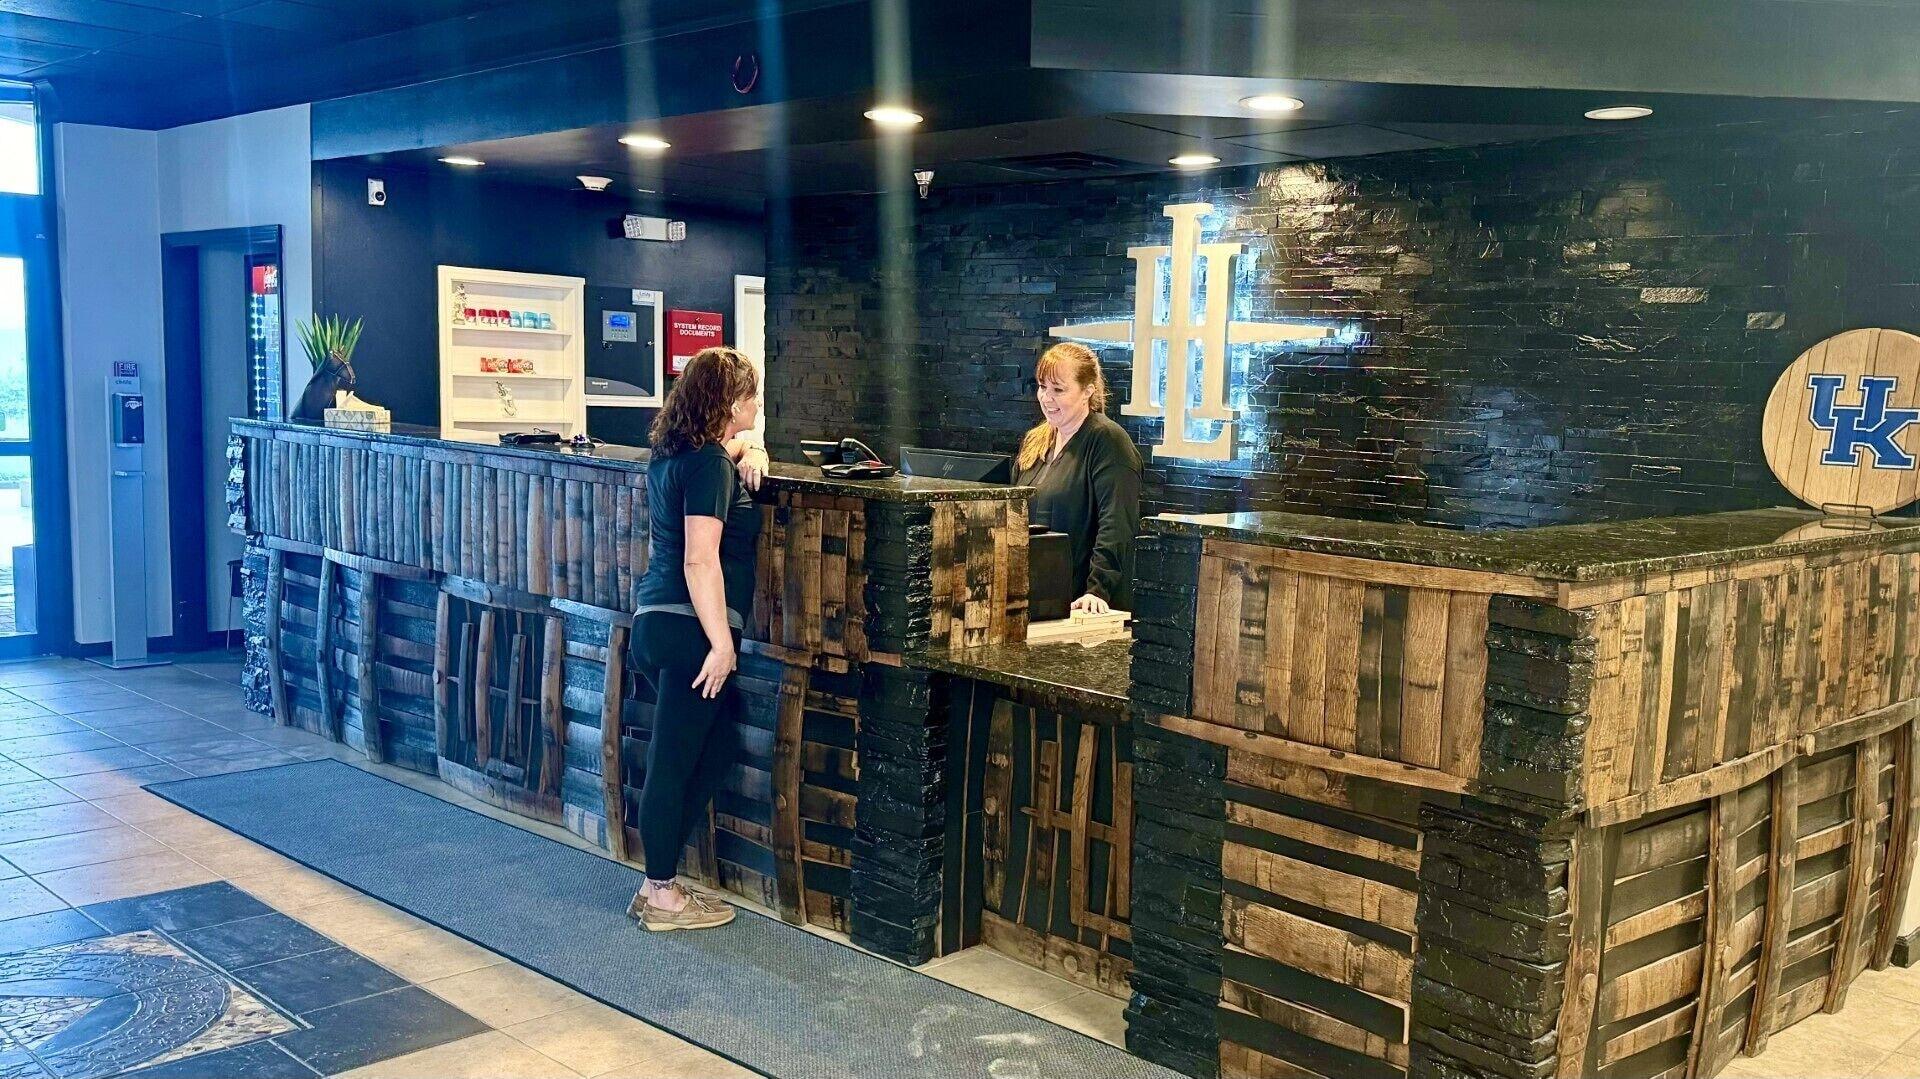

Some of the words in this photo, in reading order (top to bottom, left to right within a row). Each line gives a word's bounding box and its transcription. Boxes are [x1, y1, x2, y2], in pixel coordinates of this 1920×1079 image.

[679, 329, 716, 337] DOCUMENTS
[697, 324, 722, 332] RECORD
[1807, 373, 1920, 470] UK
[941, 460, 954, 477] hp
